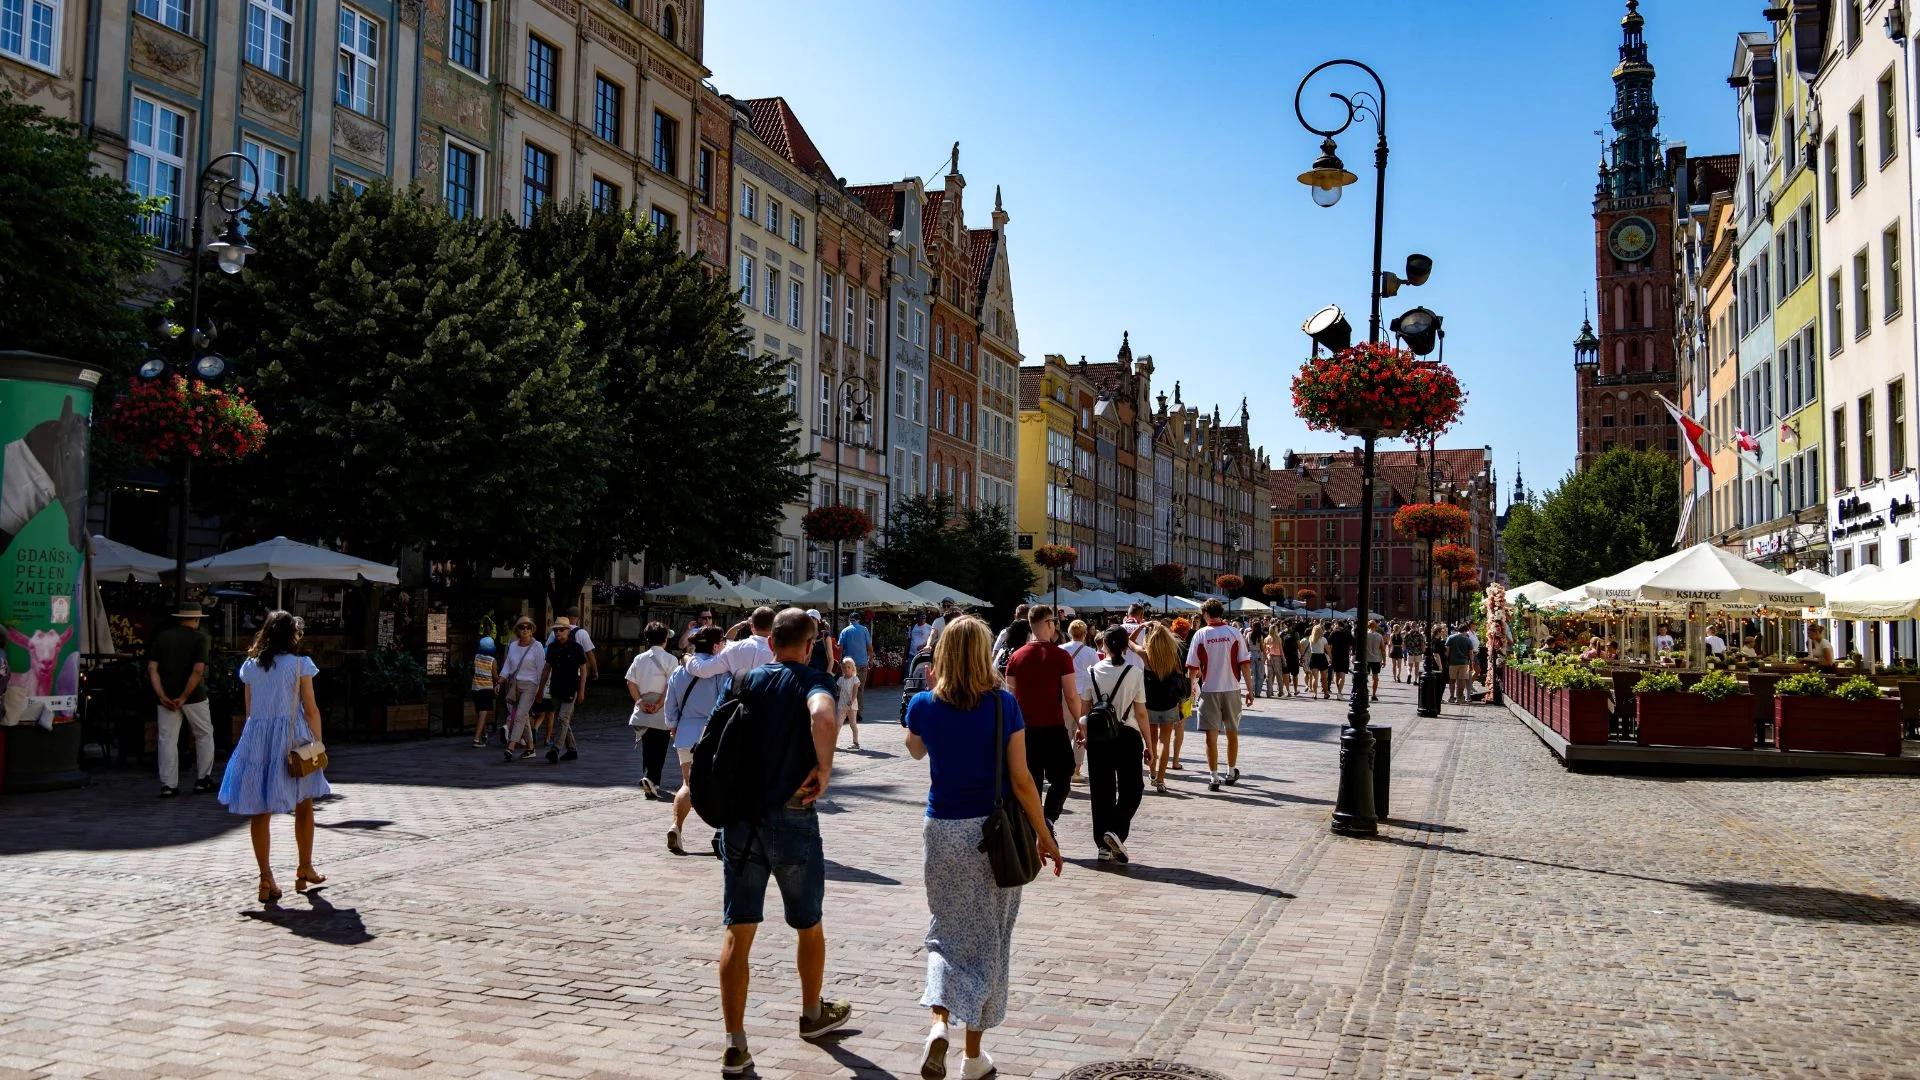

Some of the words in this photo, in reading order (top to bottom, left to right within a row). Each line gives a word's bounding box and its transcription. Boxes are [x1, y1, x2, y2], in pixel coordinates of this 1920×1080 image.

[17, 548, 73, 564] GDAŃSK
[16, 565, 64, 580] PEŁEN
[1676, 589, 1721, 600] KSIĄŻĘCE
[1769, 593, 1804, 604] KSIĄŻĘCE
